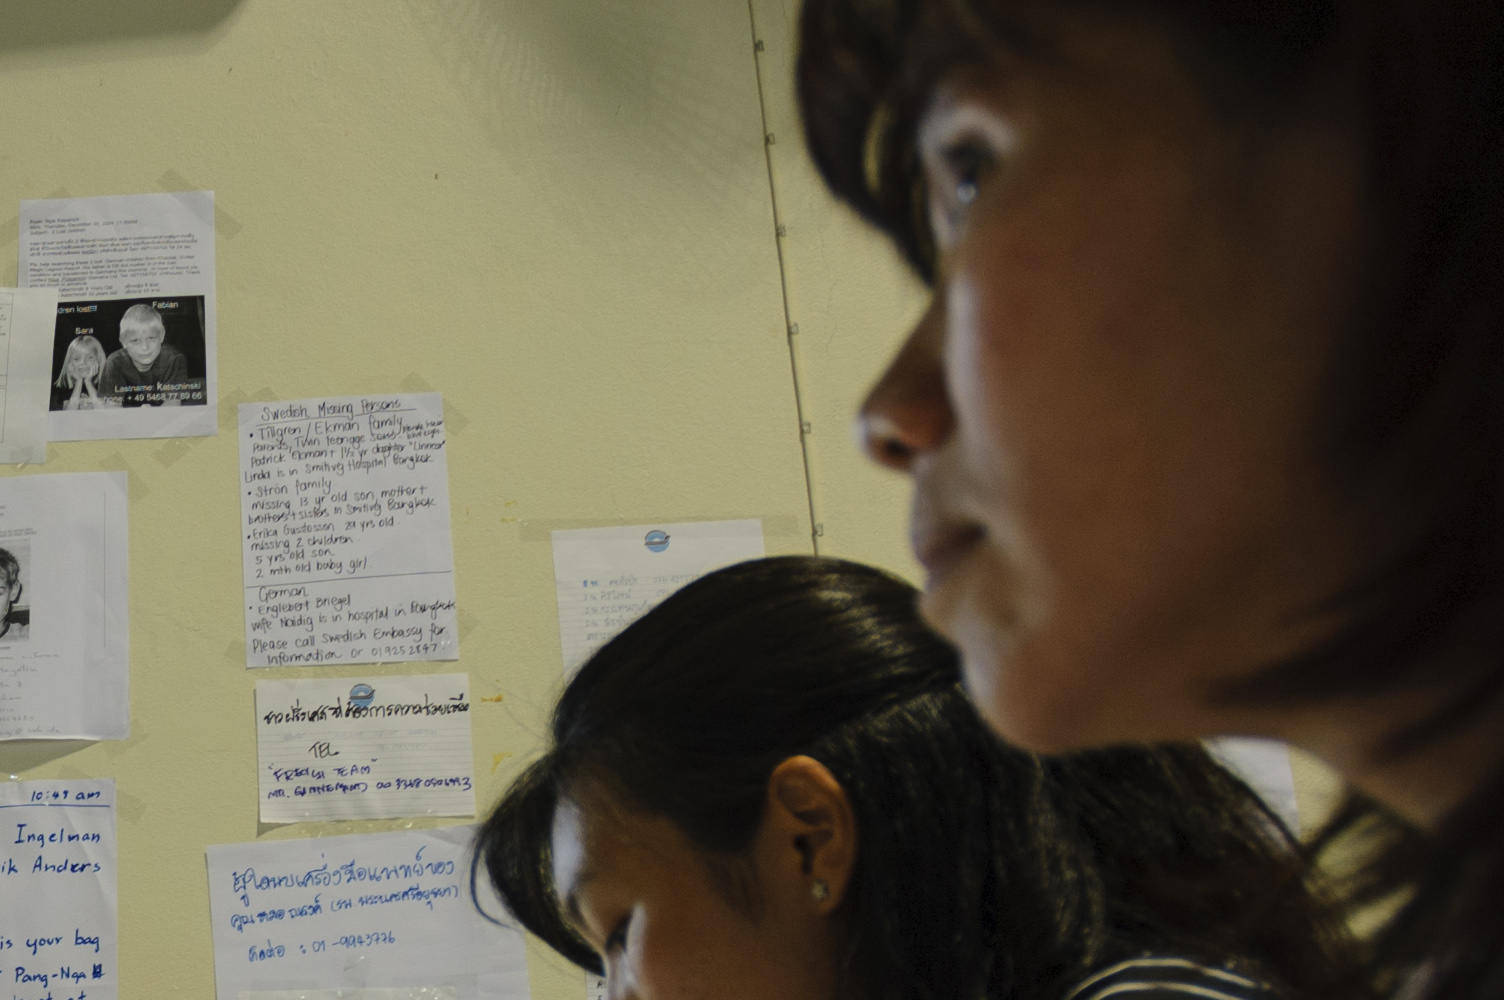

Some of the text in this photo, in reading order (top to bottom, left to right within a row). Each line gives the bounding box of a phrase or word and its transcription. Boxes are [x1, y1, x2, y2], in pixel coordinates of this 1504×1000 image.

[261, 399, 401, 422] Swedish Missing Persons
[315, 421, 360, 434] Ekman
[369, 414, 402, 435] family
[245, 470, 270, 484] Linda
[289, 469, 298, 477] in
[348, 455, 386, 474] Hospital
[393, 454, 434, 470] Bangkok
[296, 477, 332, 496] family
[252, 485, 417, 515] missing 13 yr old mother
[334, 507, 342, 515] in
[388, 498, 437, 515] Bangkok
[253, 516, 394, 540] Erika yrs old
[251, 534, 354, 555] missing 2 children
[256, 548, 335, 566] 5 yrs old son
[256, 557, 367, 579] 2 mth old baby girl
[259, 586, 309, 604] German
[251, 617, 272, 634] wife
[319, 613, 327, 623] is
[332, 612, 342, 622] in
[348, 606, 389, 624] hospital
[395, 604, 407, 616] in
[252, 622, 446, 654] Please call Swedish Embassy for
[267, 648, 364, 666] Information or
[309, 741, 340, 759] TEL
[14, 823, 101, 848] Ingelman
[32, 855, 102, 875] Anders
[0, 936, 13, 950] is
[25, 936, 63, 956] your
[74, 928, 100, 953] bag
